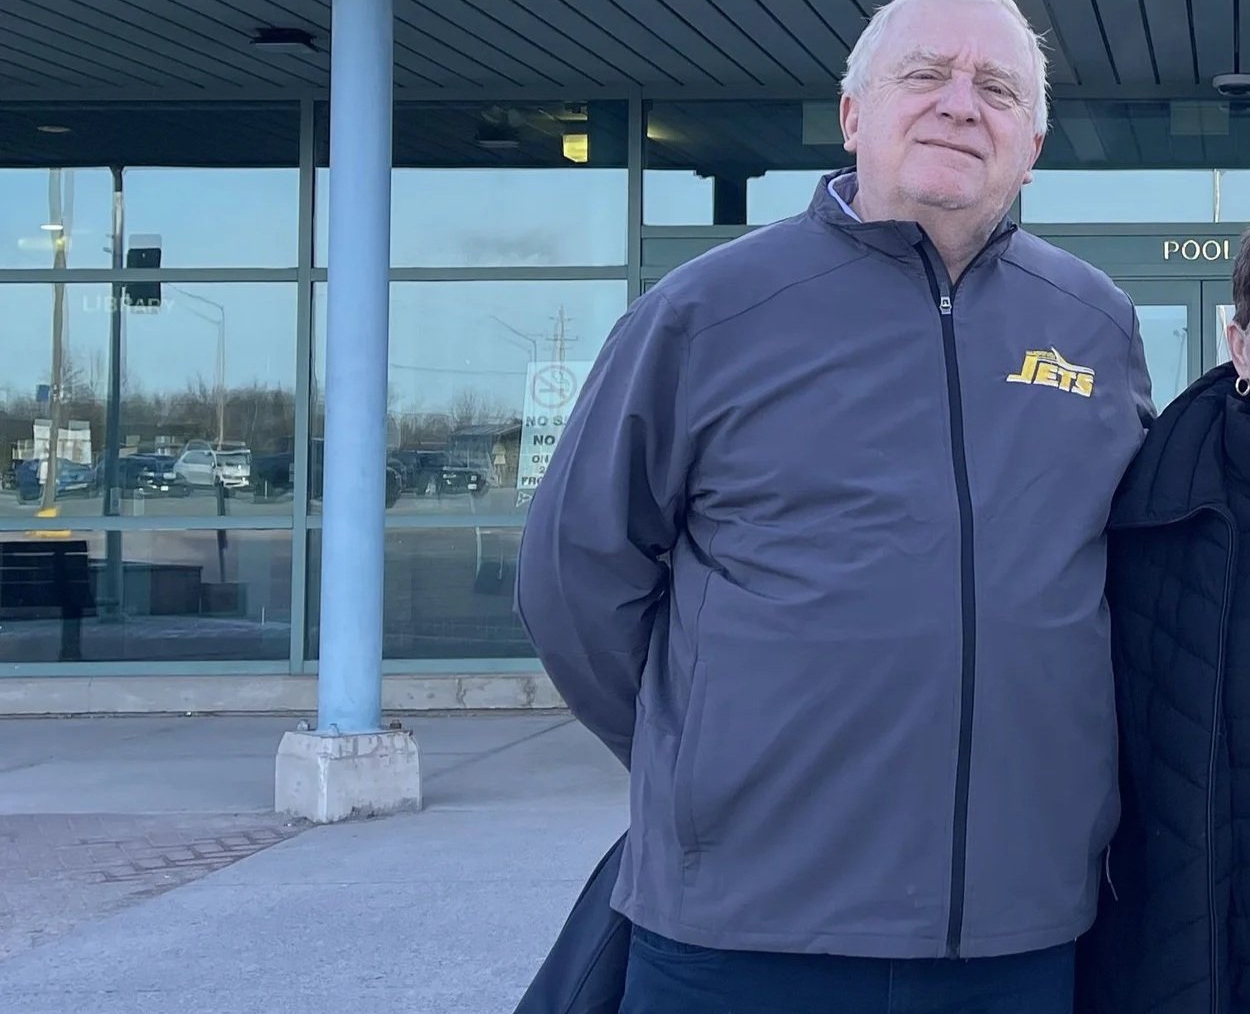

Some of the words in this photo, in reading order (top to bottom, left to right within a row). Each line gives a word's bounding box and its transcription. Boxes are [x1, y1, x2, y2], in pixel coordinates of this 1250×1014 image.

[82, 294, 175, 314] LIBRARY
[1006, 349, 1095, 397] JETS
[525, 415, 548, 427] NO
[533, 434, 556, 446] NO
